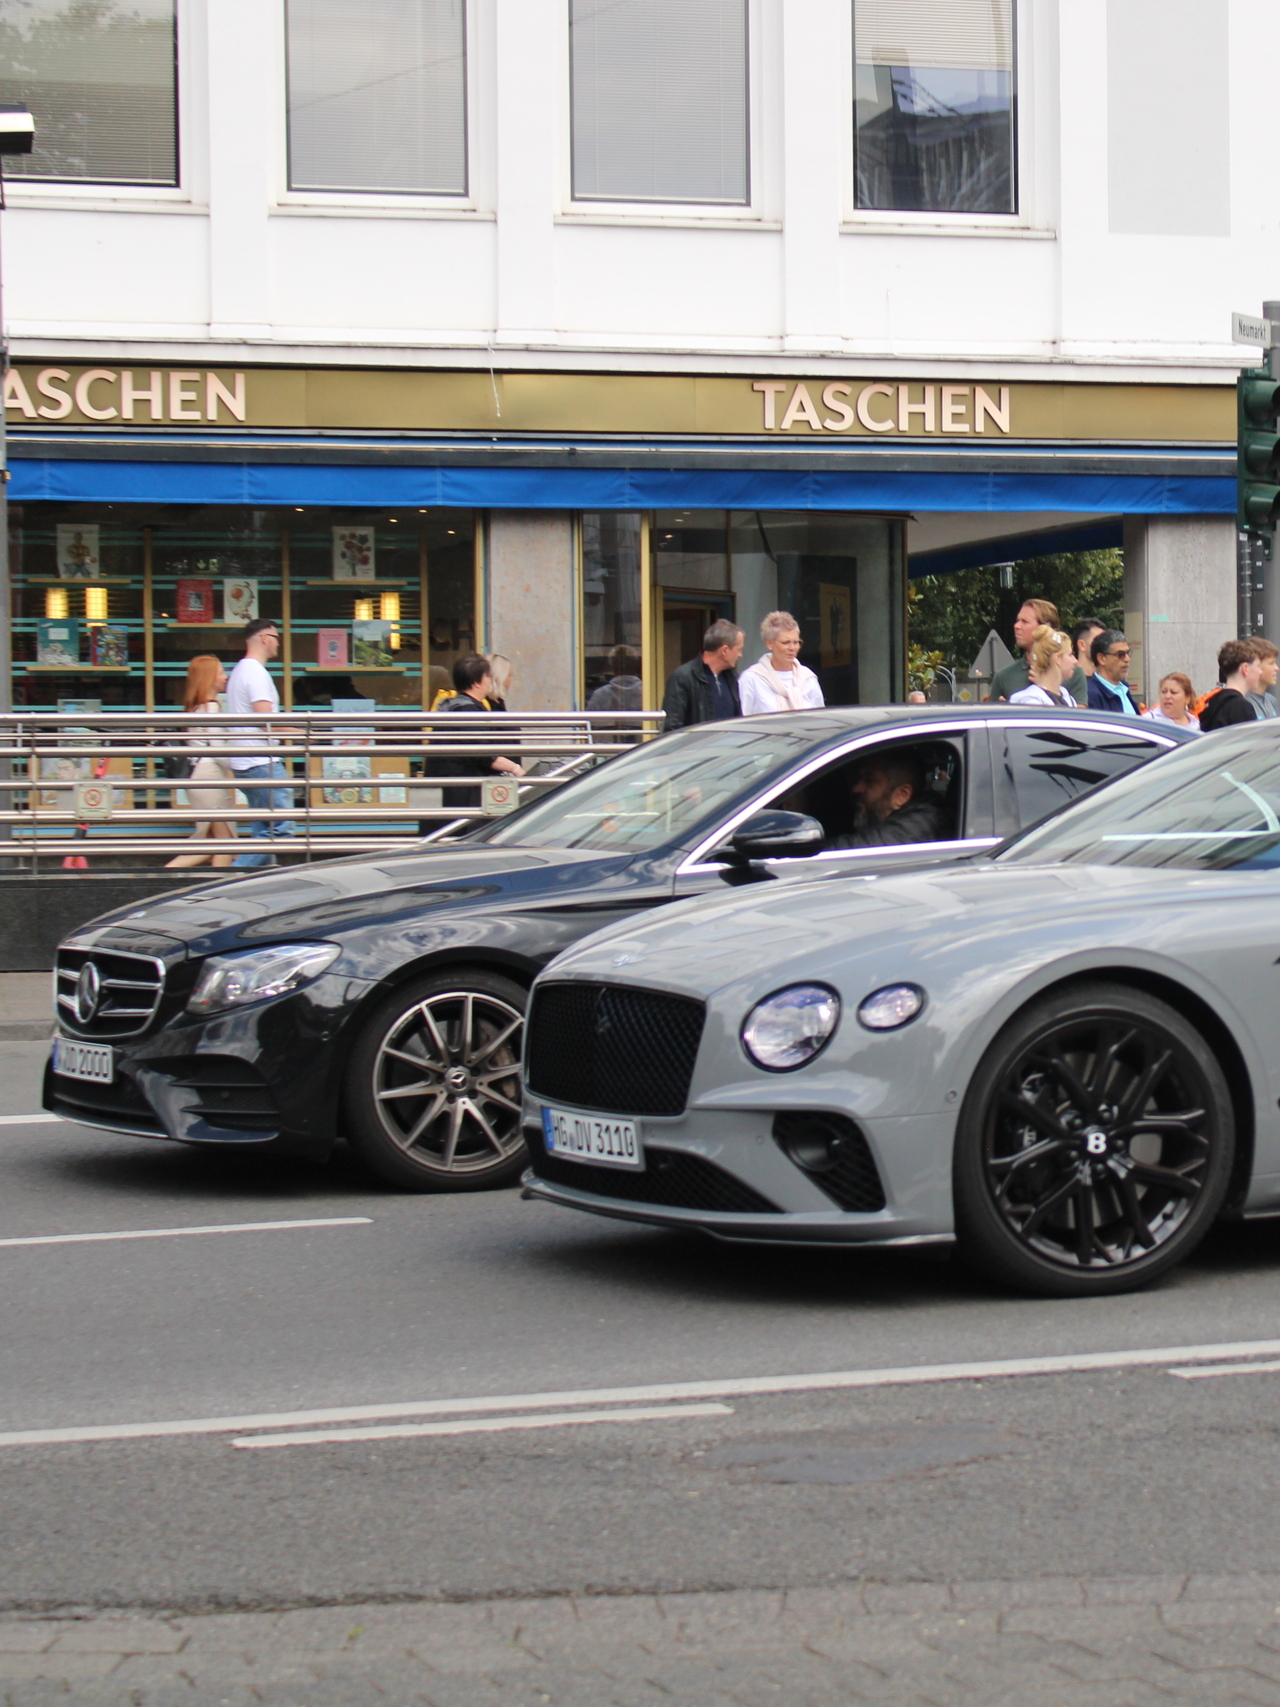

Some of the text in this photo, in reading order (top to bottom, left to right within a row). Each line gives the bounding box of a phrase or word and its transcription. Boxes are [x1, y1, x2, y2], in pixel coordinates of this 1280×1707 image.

[1238, 318, 1267, 341] Neumarkt
[752, 381, 1010, 434] TASCHEN
[552, 1113, 568, 1147] HG
[595, 1122, 635, 1158] 3110
[1087, 1132, 1107, 1154] B
